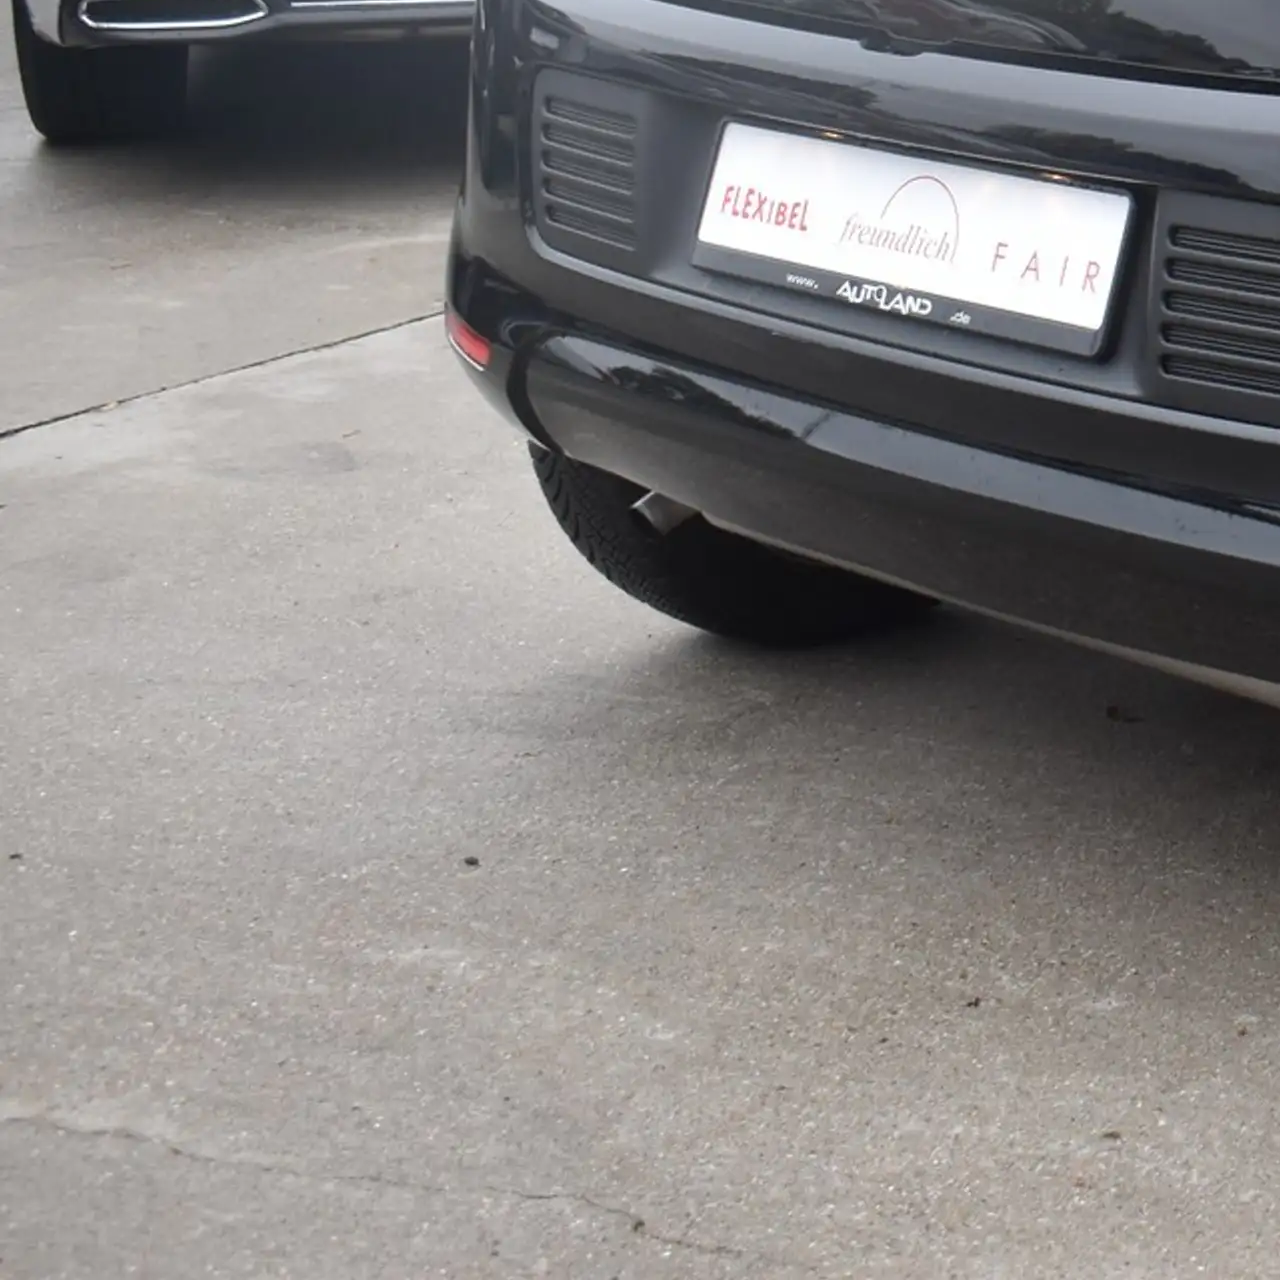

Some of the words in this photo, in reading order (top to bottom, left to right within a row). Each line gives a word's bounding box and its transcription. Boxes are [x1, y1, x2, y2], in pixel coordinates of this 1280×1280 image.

[720, 184, 809, 232] FLEXIBEL
[839, 213, 957, 265] freundlich
[835, 279, 933, 317] AUTOLAND
